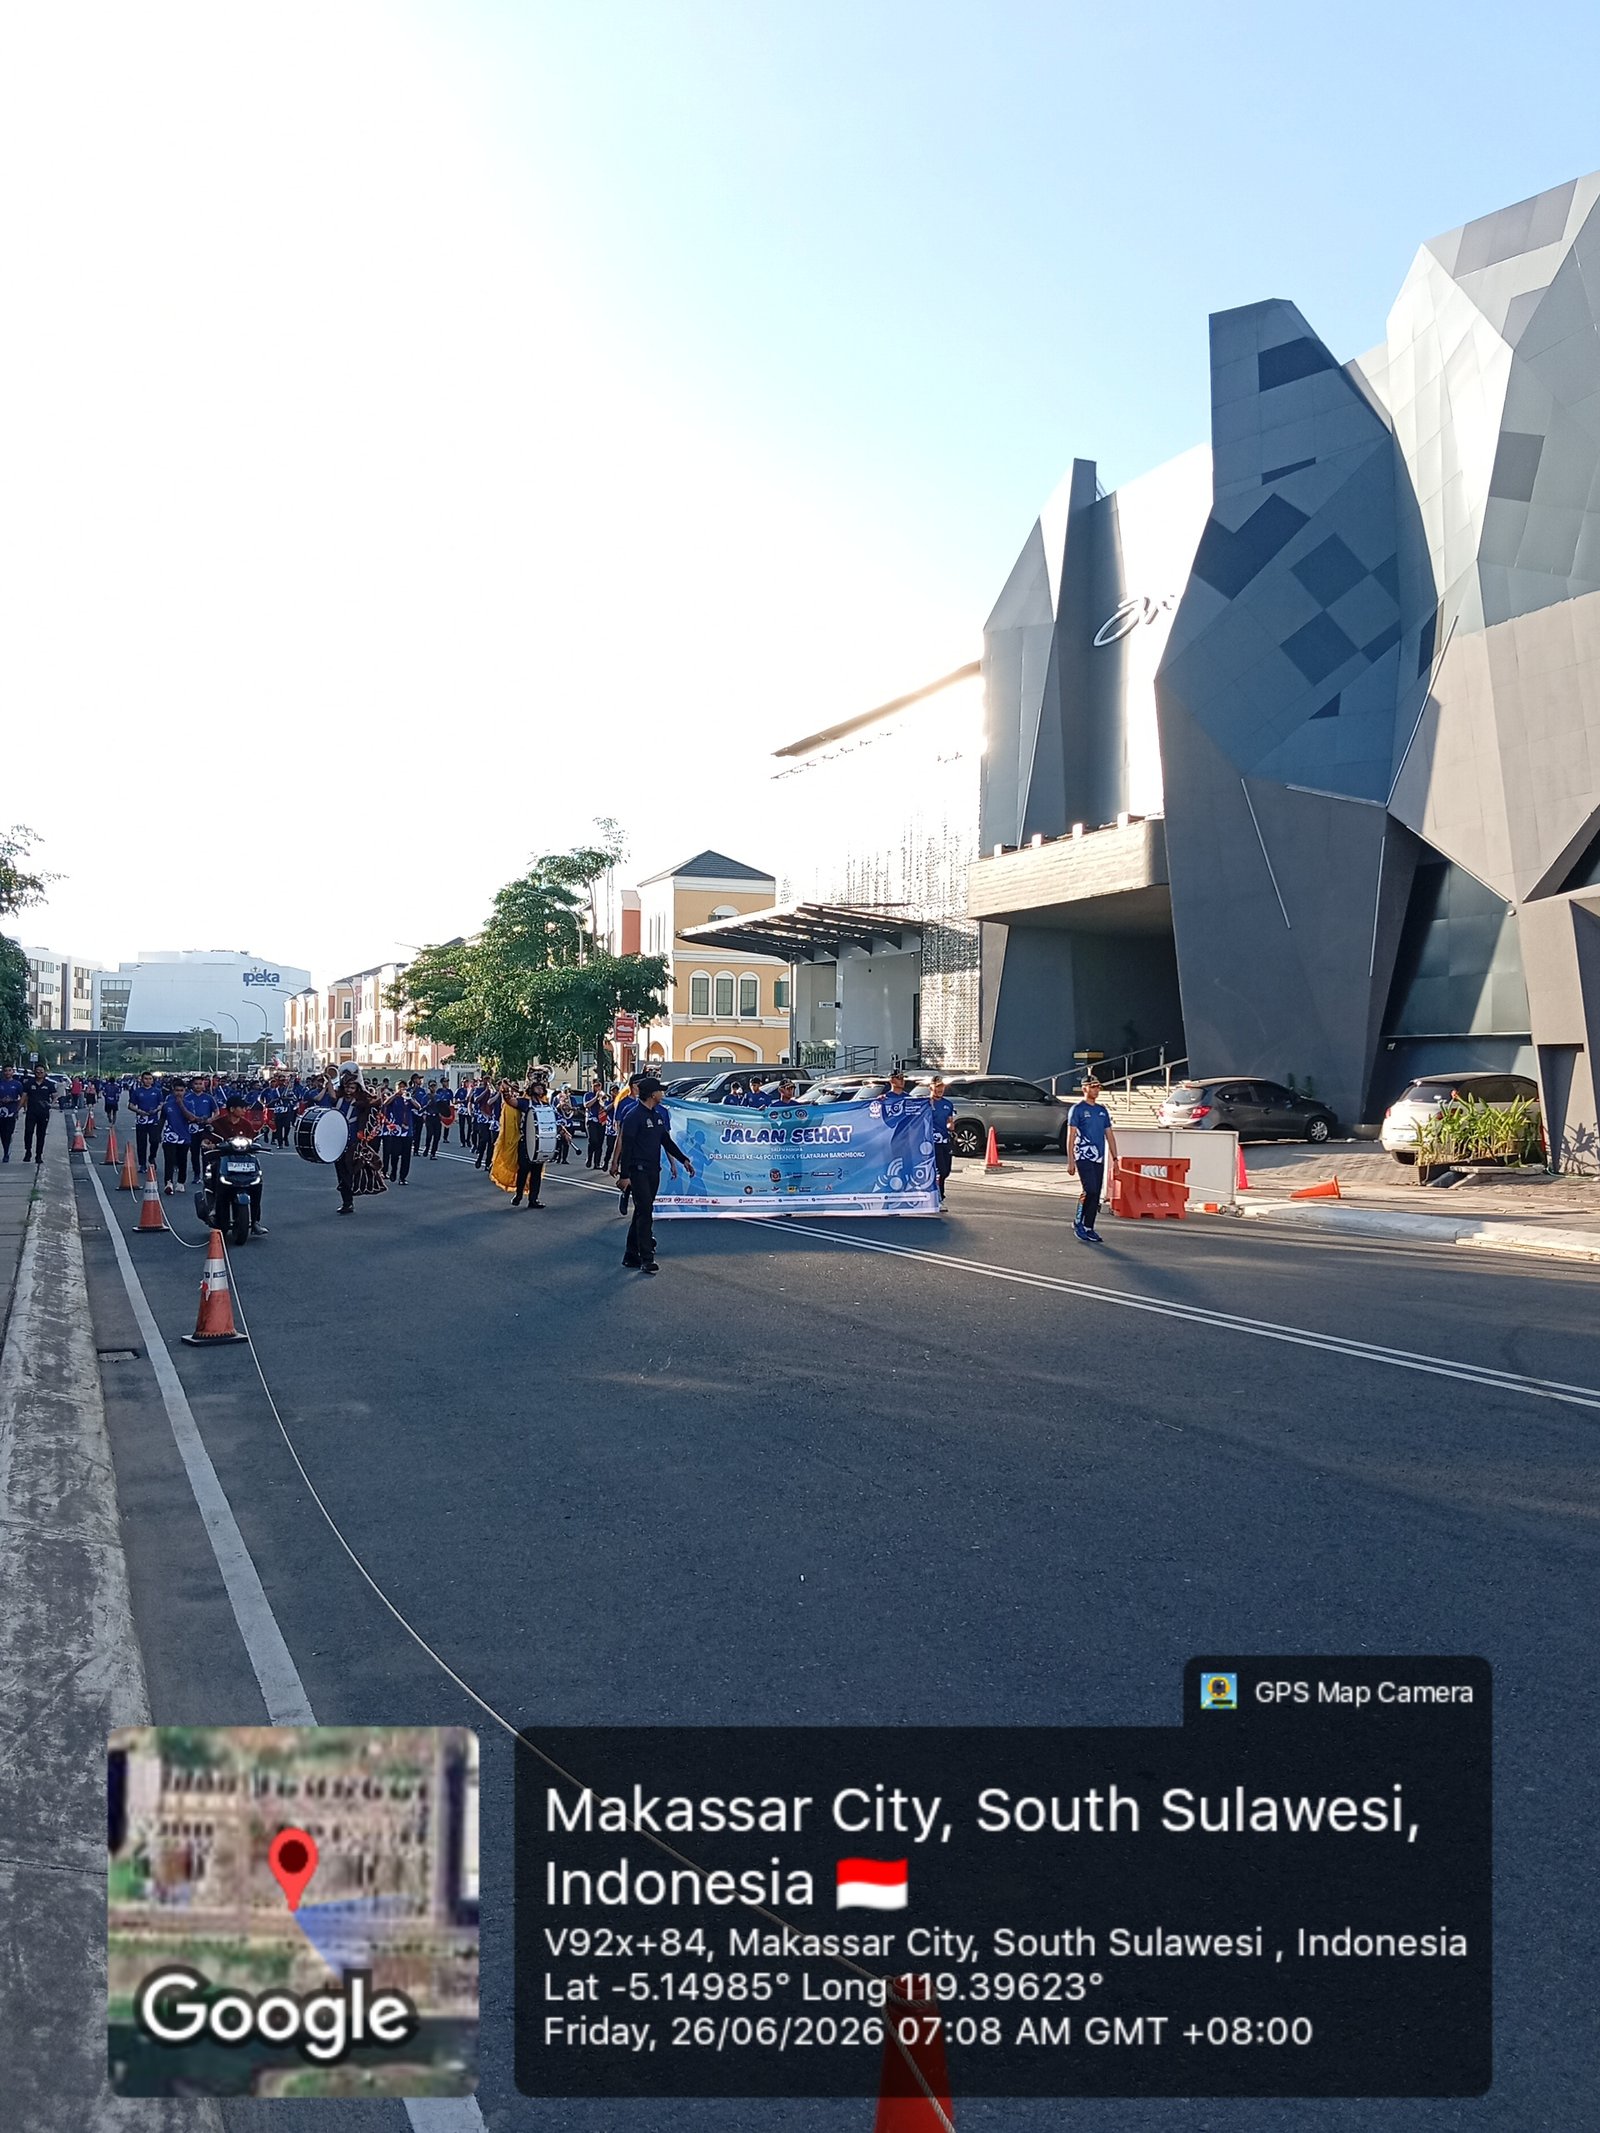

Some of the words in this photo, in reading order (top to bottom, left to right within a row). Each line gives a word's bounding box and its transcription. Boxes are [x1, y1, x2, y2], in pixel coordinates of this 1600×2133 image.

[720, 1127, 787, 1145] JALAN
[790, 1126, 853, 1145] SEHAT
[723, 1170, 741, 1181] btn
